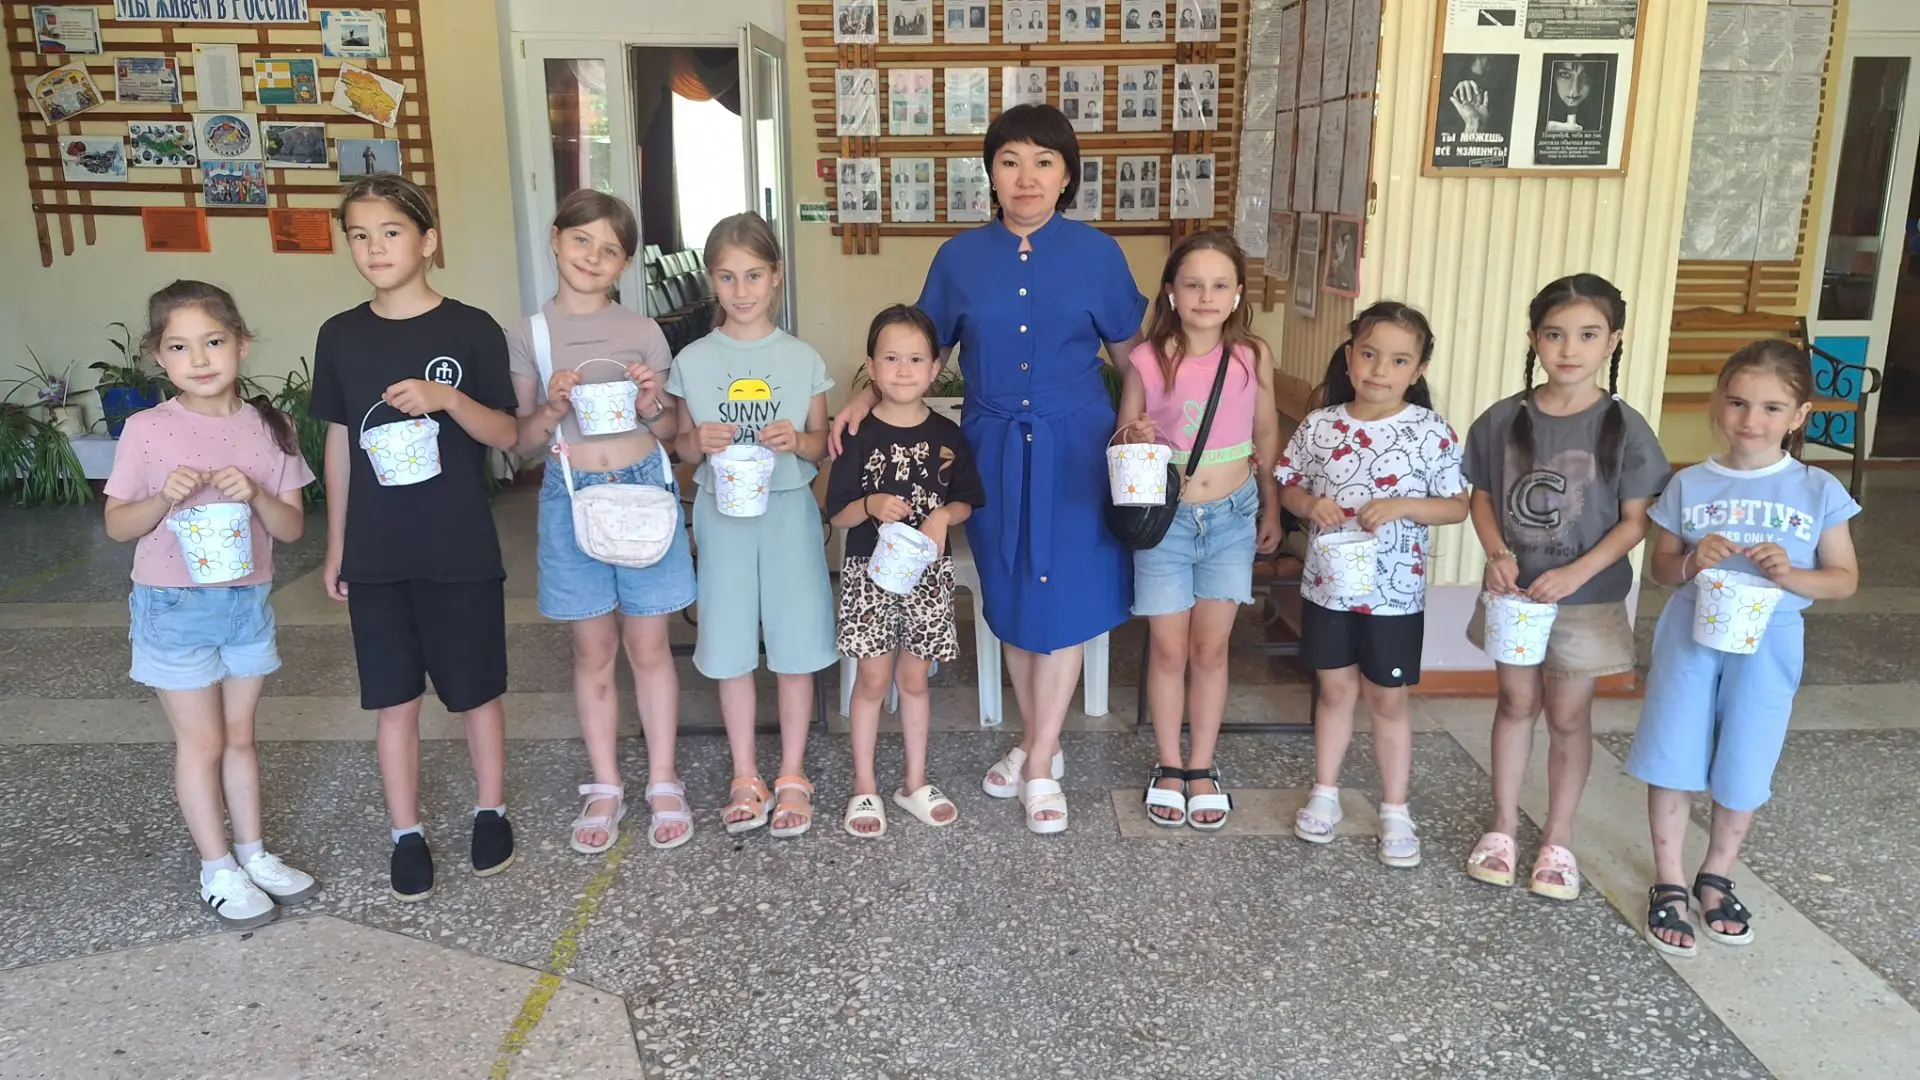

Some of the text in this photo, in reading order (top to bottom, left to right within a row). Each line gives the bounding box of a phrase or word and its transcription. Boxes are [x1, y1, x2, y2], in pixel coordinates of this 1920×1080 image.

[1441, 132, 1504, 143] ТЫ МОЖЕШЬ
[1456, 146, 1508, 157] ИЗМЕНИТЬ!
[718, 401, 781, 423] SUNNY
[1507, 470, 1566, 528] C
[1682, 499, 1814, 541] POSITIVE
[1744, 532, 1774, 543] ONLY
